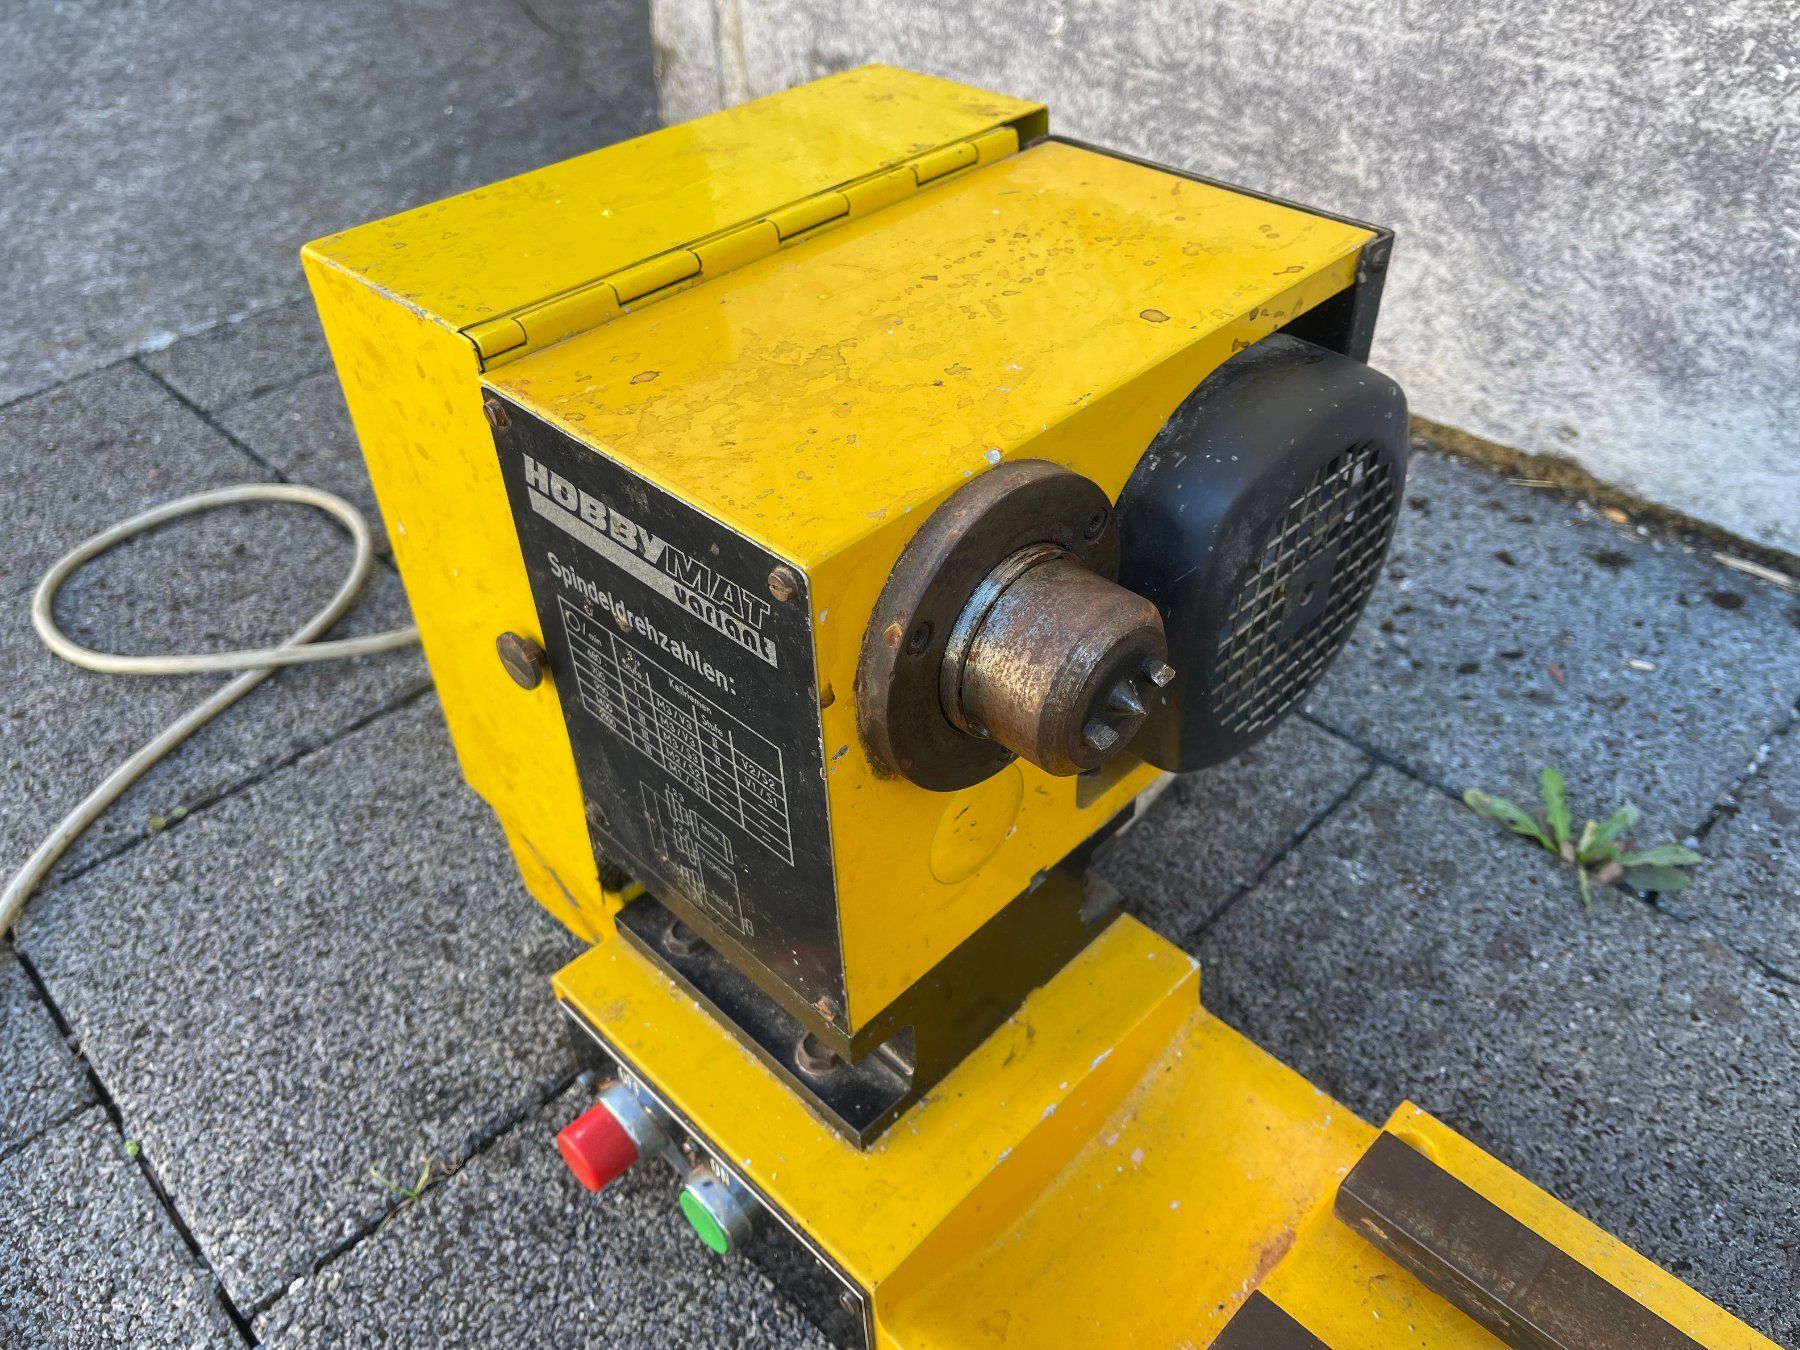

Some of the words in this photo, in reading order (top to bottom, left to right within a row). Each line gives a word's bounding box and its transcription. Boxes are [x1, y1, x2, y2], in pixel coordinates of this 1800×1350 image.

[548, 551, 736, 695] Spindeldrehzahlen:
[668, 677, 713, 715] Keilriemen
[701, 713, 724, 738] Stufe
